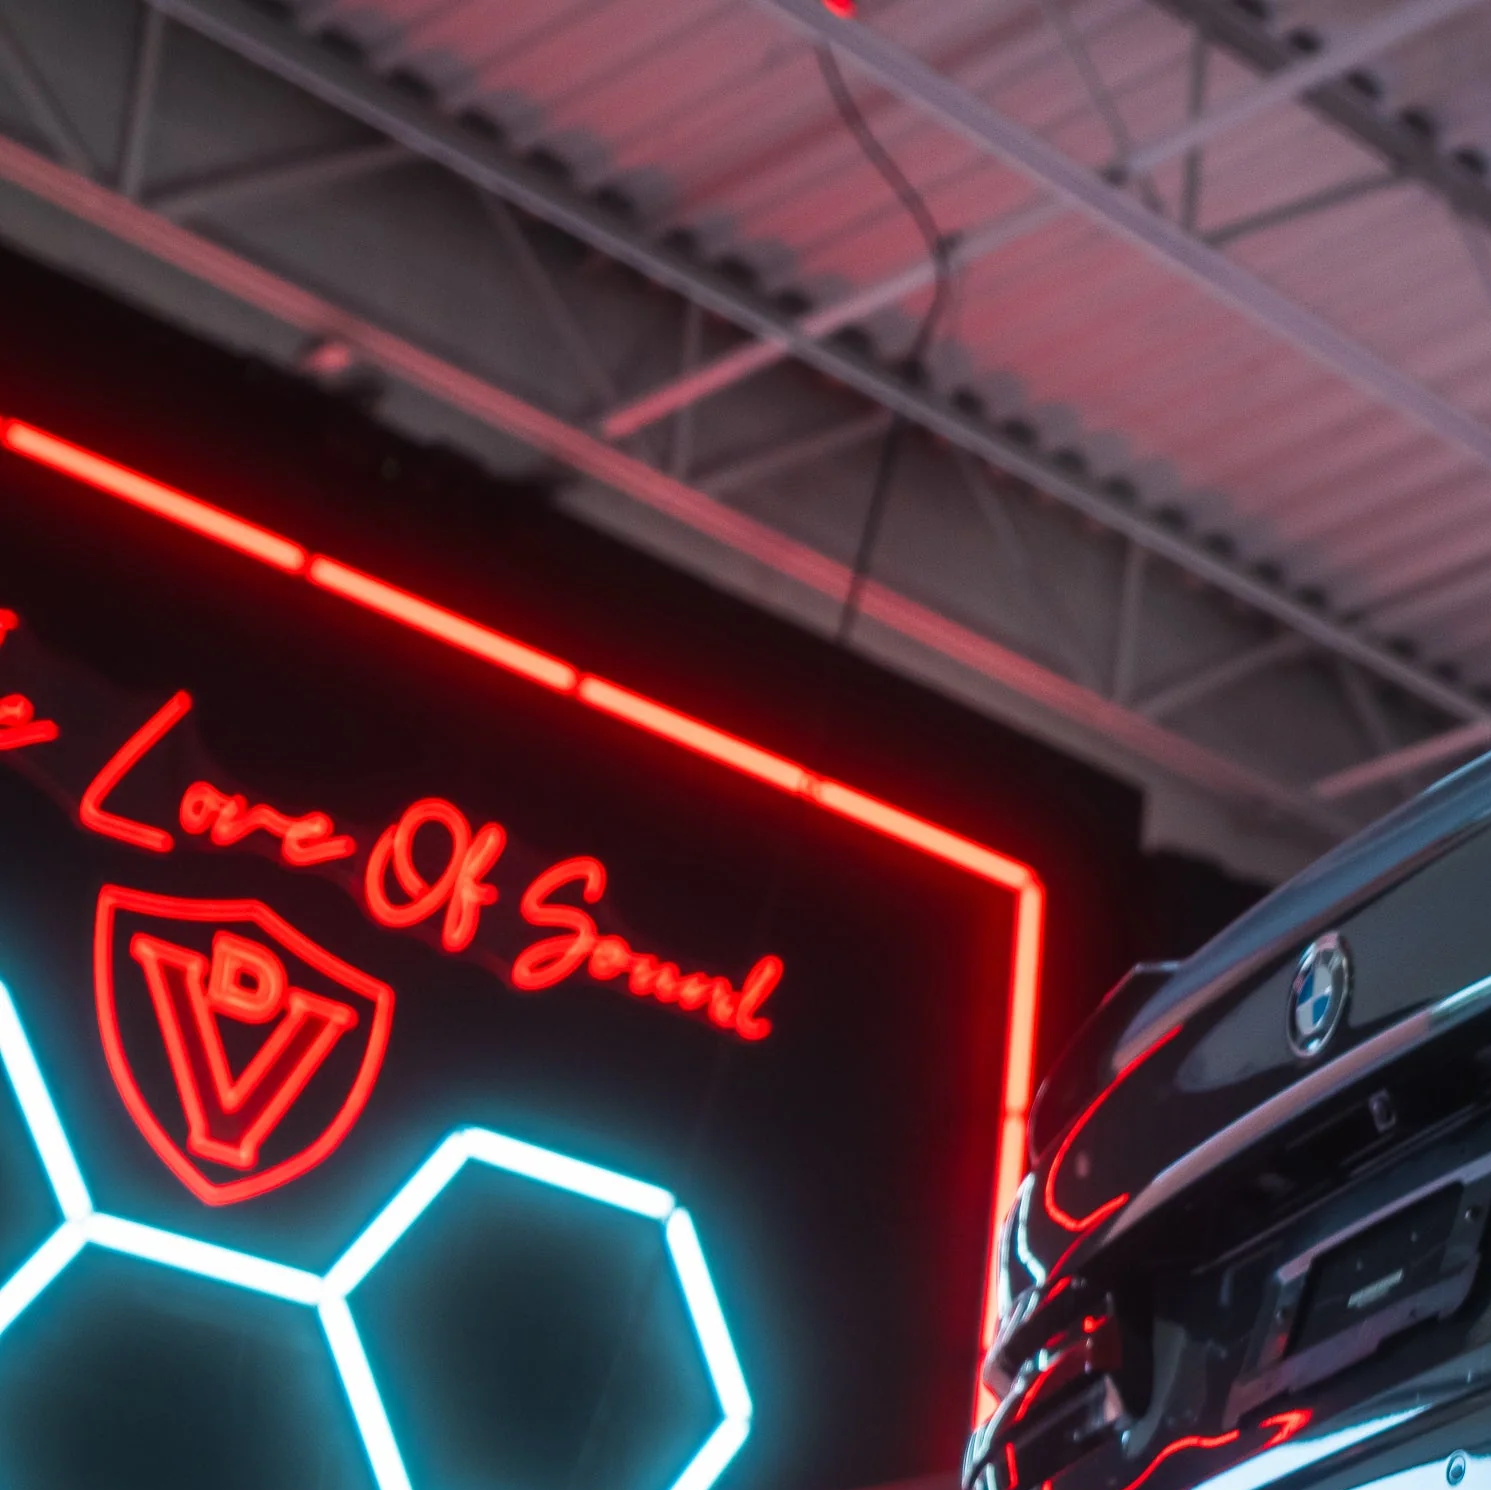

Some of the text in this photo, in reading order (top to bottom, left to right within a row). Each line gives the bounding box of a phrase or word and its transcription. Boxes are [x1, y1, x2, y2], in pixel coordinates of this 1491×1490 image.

[79, 690, 785, 1041] Love Of Sound
